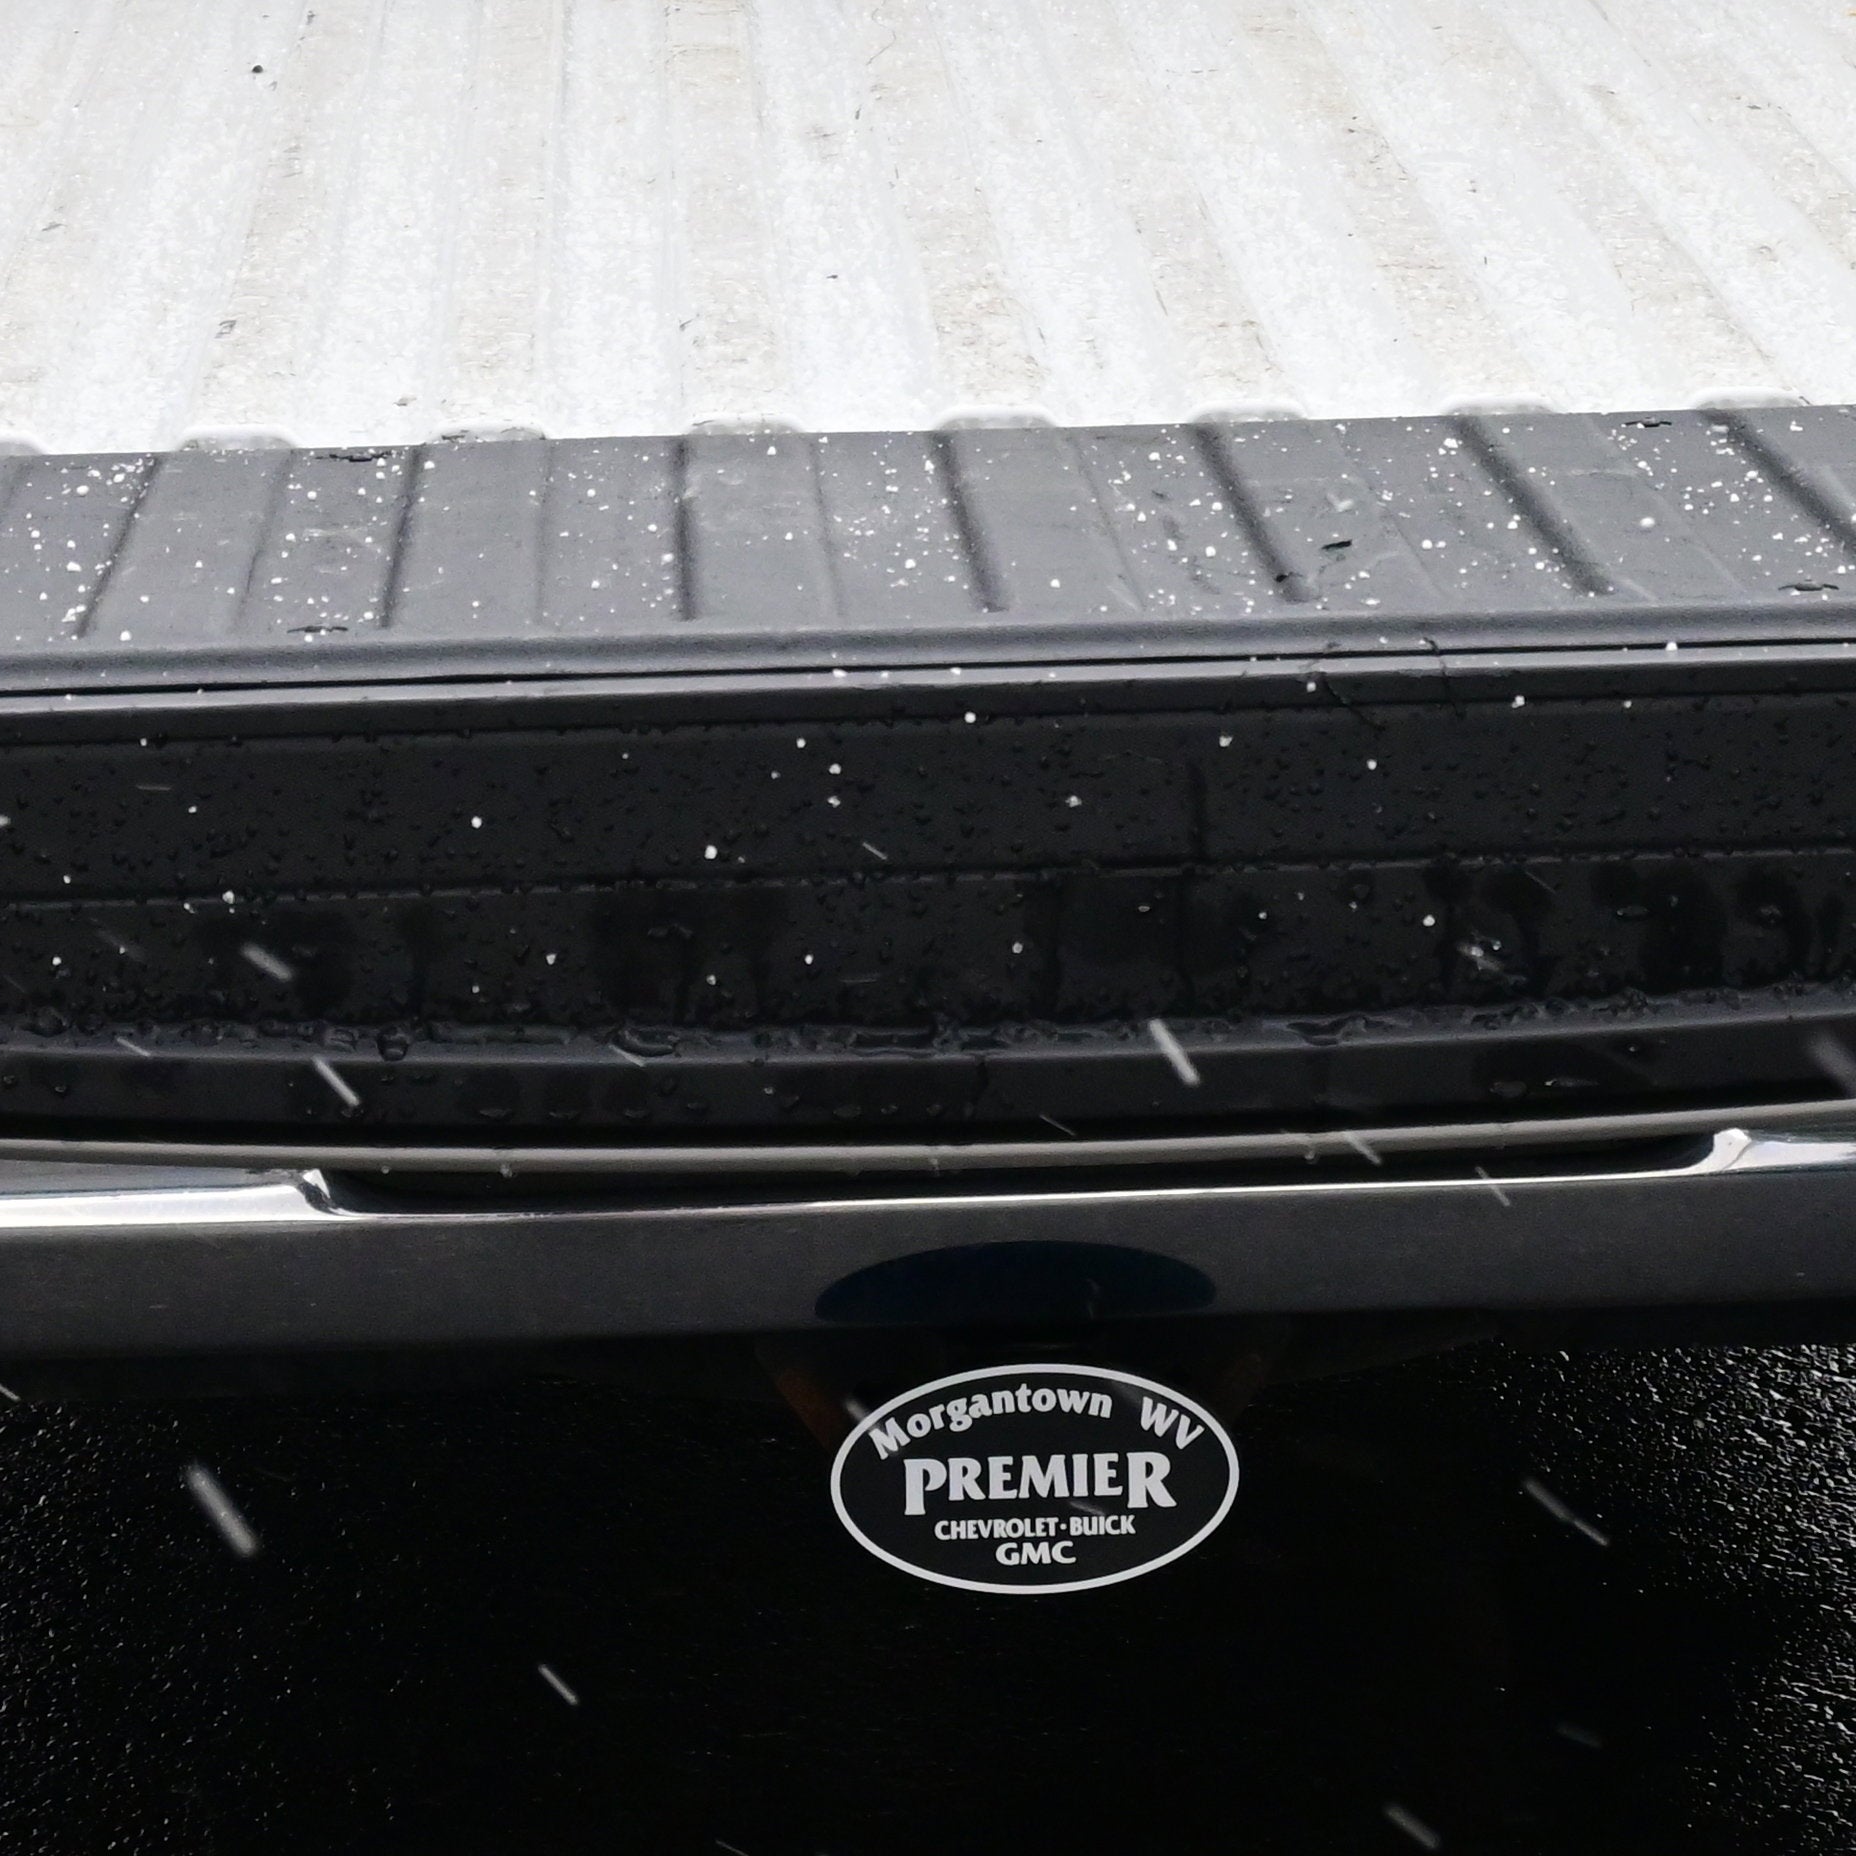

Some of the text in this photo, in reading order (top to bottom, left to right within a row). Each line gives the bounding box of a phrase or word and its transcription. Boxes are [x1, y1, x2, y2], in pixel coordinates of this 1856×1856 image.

[868, 1383, 1205, 1459] Morgantown WV
[903, 1451, 1177, 1516] PREMIER
[995, 1540, 1077, 1566] GMC
